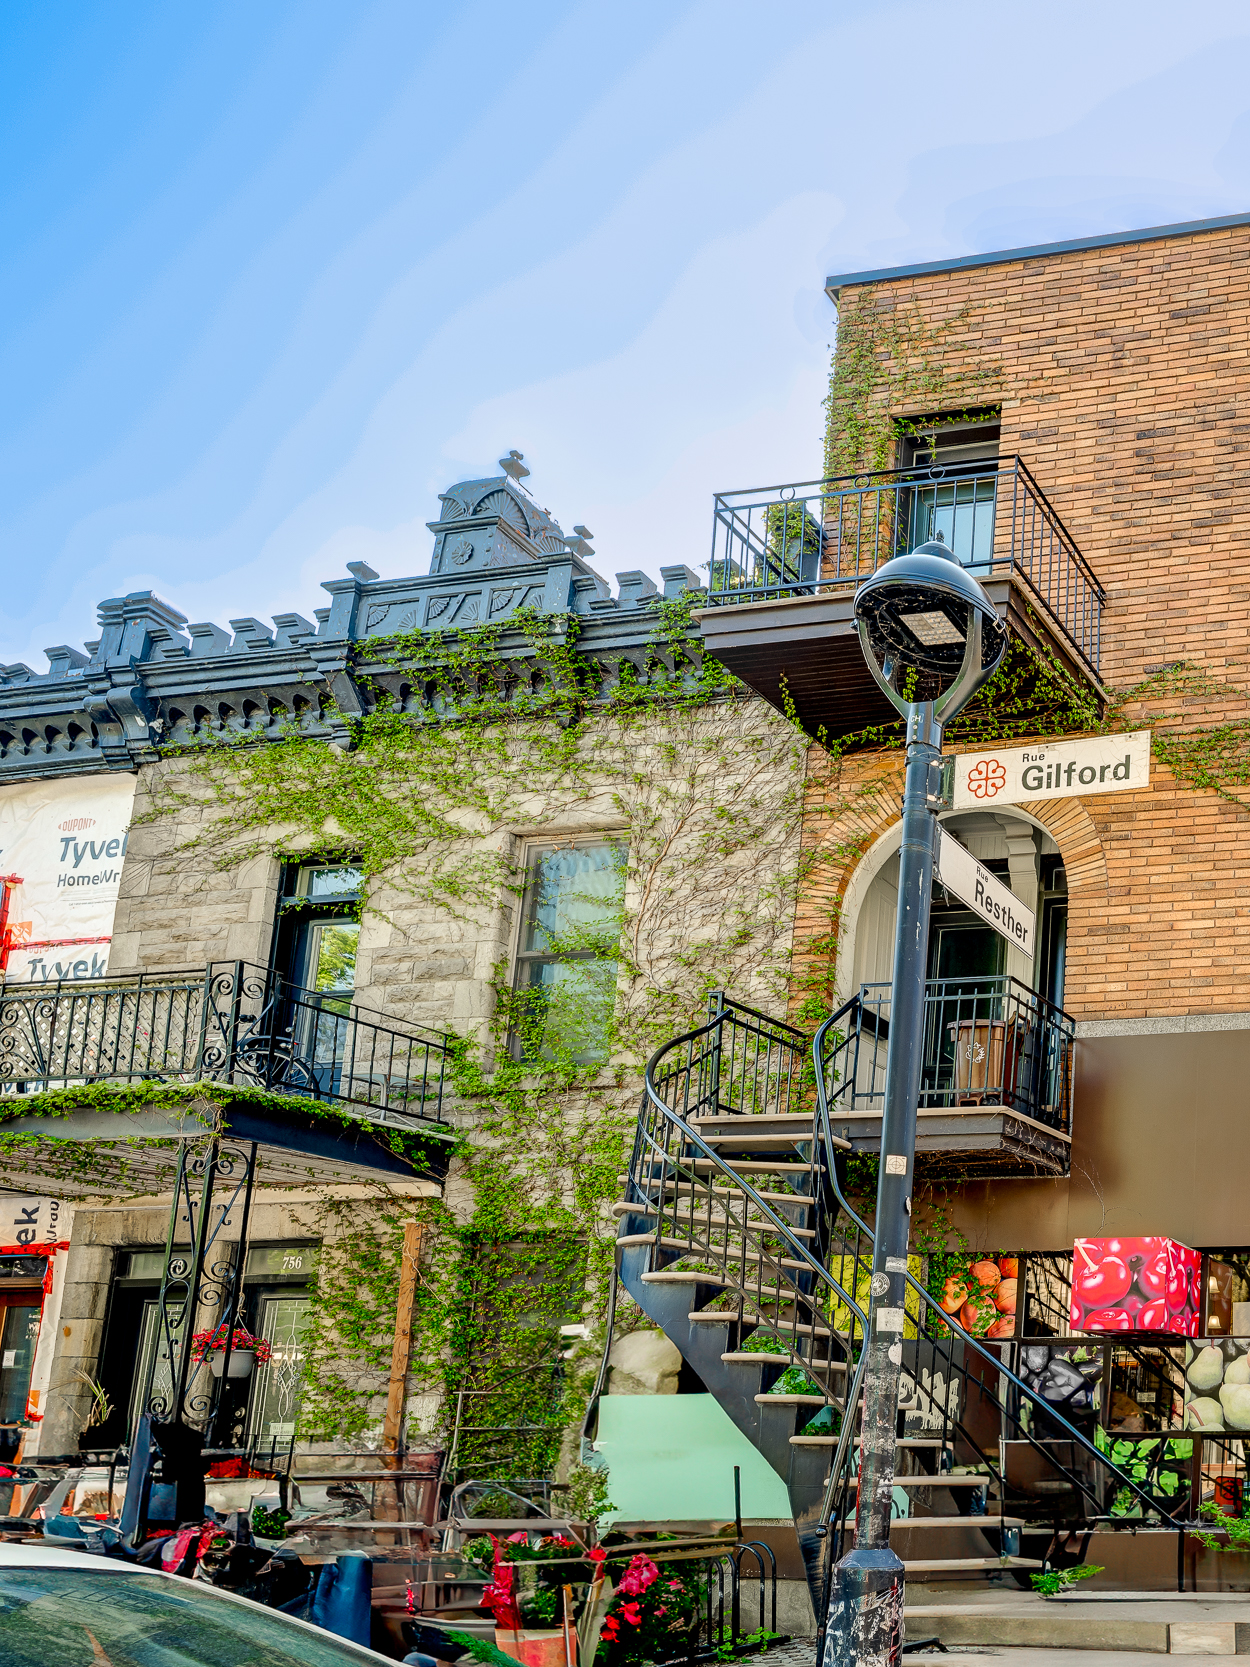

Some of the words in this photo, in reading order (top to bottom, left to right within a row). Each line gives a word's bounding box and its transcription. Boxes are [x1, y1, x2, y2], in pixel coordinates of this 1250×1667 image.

[1022, 753, 1046, 763] Rue
[1021, 755, 1131, 791] Gilford
[62, 817, 93, 832] DUPONT
[57, 869, 121, 888] HomeWr
[976, 865, 989, 884] Rue
[974, 878, 1028, 944] Resther
[282, 1256, 303, 1270] 756
